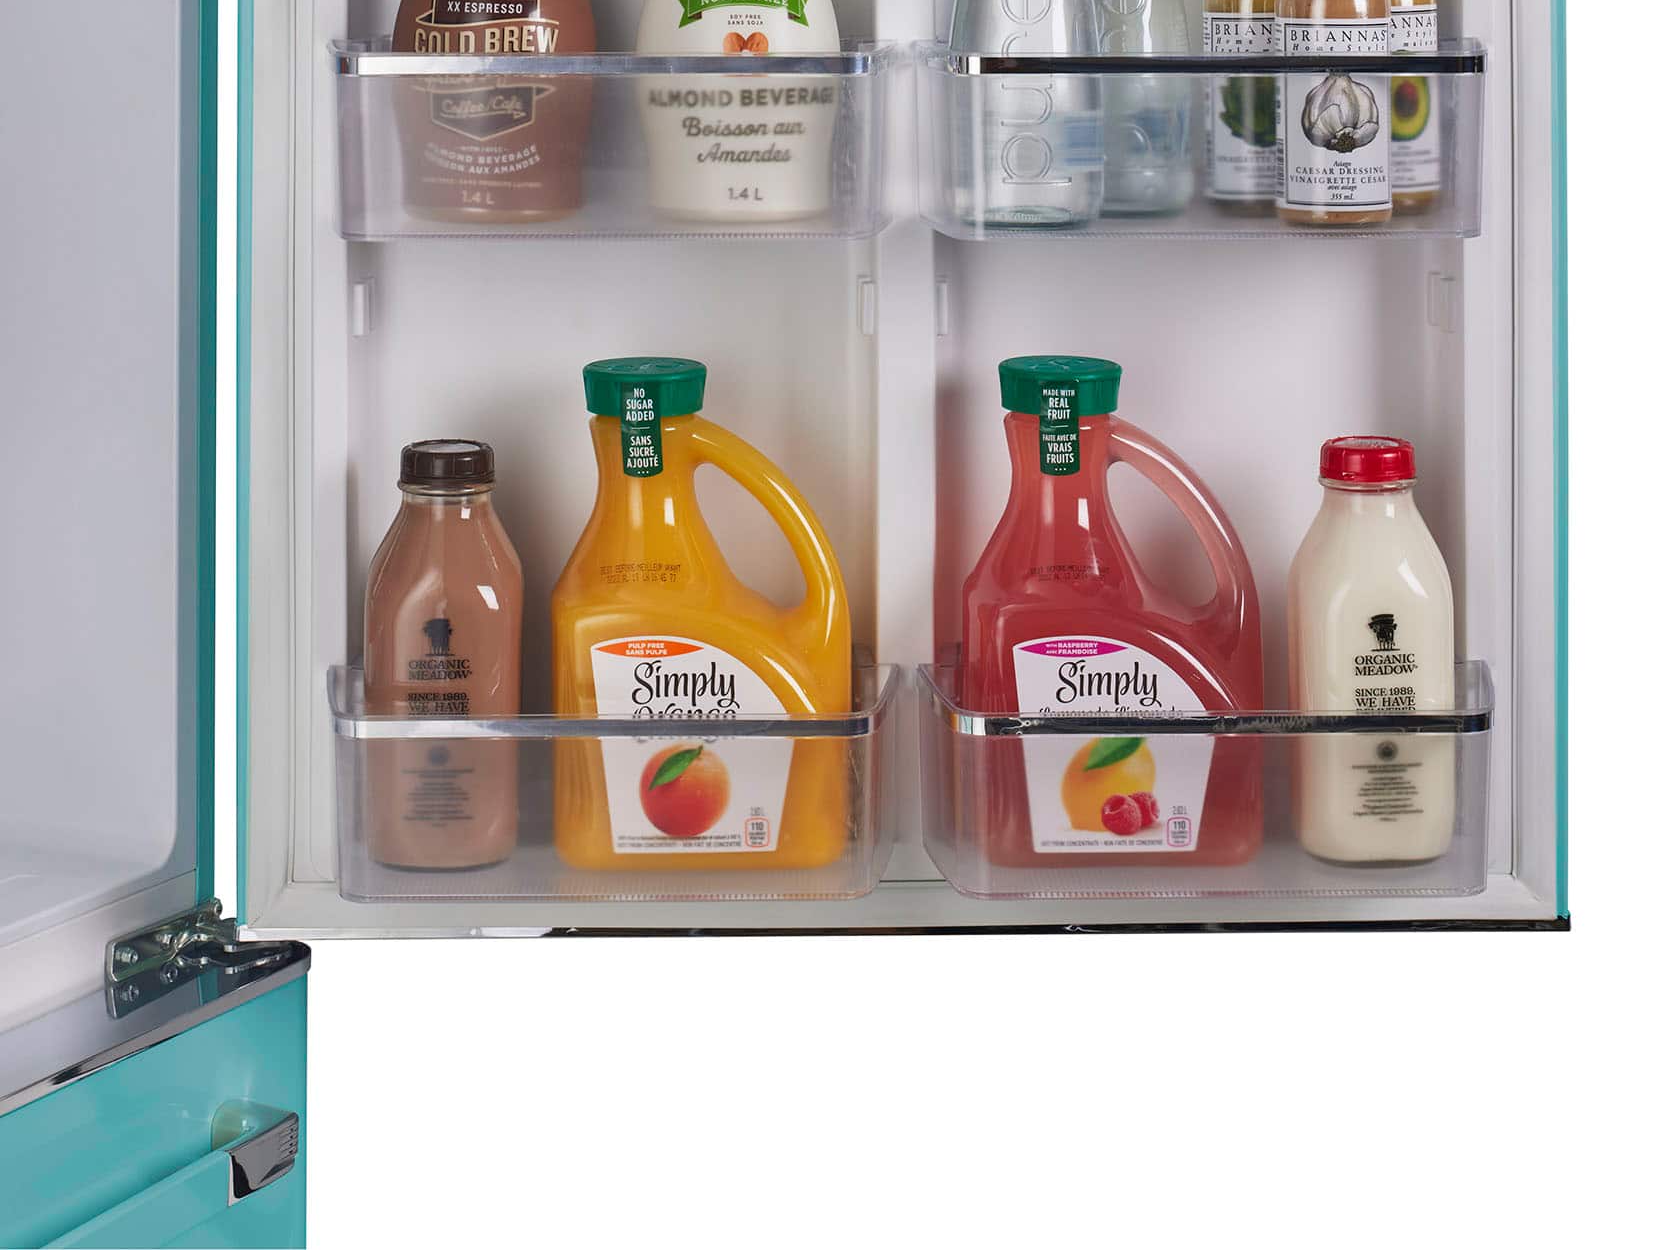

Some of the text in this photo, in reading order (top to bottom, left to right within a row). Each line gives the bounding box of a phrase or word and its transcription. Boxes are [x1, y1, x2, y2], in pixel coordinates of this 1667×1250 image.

[447, 1, 523, 14] XX ESPRESSO
[1216, 23, 1273, 35] BRIAN
[415, 25, 559, 54] COLD BREW
[1291, 29, 1387, 42] BRIANNAS
[649, 88, 733, 108] ALMOND
[682, 116, 806, 137] Boisson aux
[478, 145, 537, 164] BEVERAGE
[697, 142, 792, 163] Amandes
[469, 155, 541, 174] AUX AMANDES
[1295, 166, 1384, 175] CAESAR DRESSING
[1289, 174, 1357, 184] VINAIGRETTE
[486, 191, 495, 205] L
[727, 187, 763, 201] 1.4 L
[633, 388, 645, 398] NO
[1060, 389, 1075, 397] WITH
[626, 399, 654, 410] SUGAR
[1048, 398, 1069, 409] REAL
[626, 410, 655, 421] ADDED
[1047, 409, 1071, 420] FRUIT
[630, 435, 652, 446] SANS
[629, 446, 655, 457] SUCRE
[1047, 442, 1072, 452] VRAIS
[627, 454, 658, 468] AJOUTÉ
[1046, 452, 1074, 464] FRUITS
[408, 659, 470, 670] ORGANIC
[1354, 653, 1415, 665] ORGANIC
[632, 660, 740, 709] Simply
[1056, 659, 1162, 708] Simply
[408, 692, 440, 701] SINCE
[1354, 688, 1387, 697] SINCE
[435, 701, 470, 712] HAVE
[1356, 696, 1416, 708] WE HAVE
[751, 821, 764, 830] 110
[1173, 821, 1186, 830] 110
